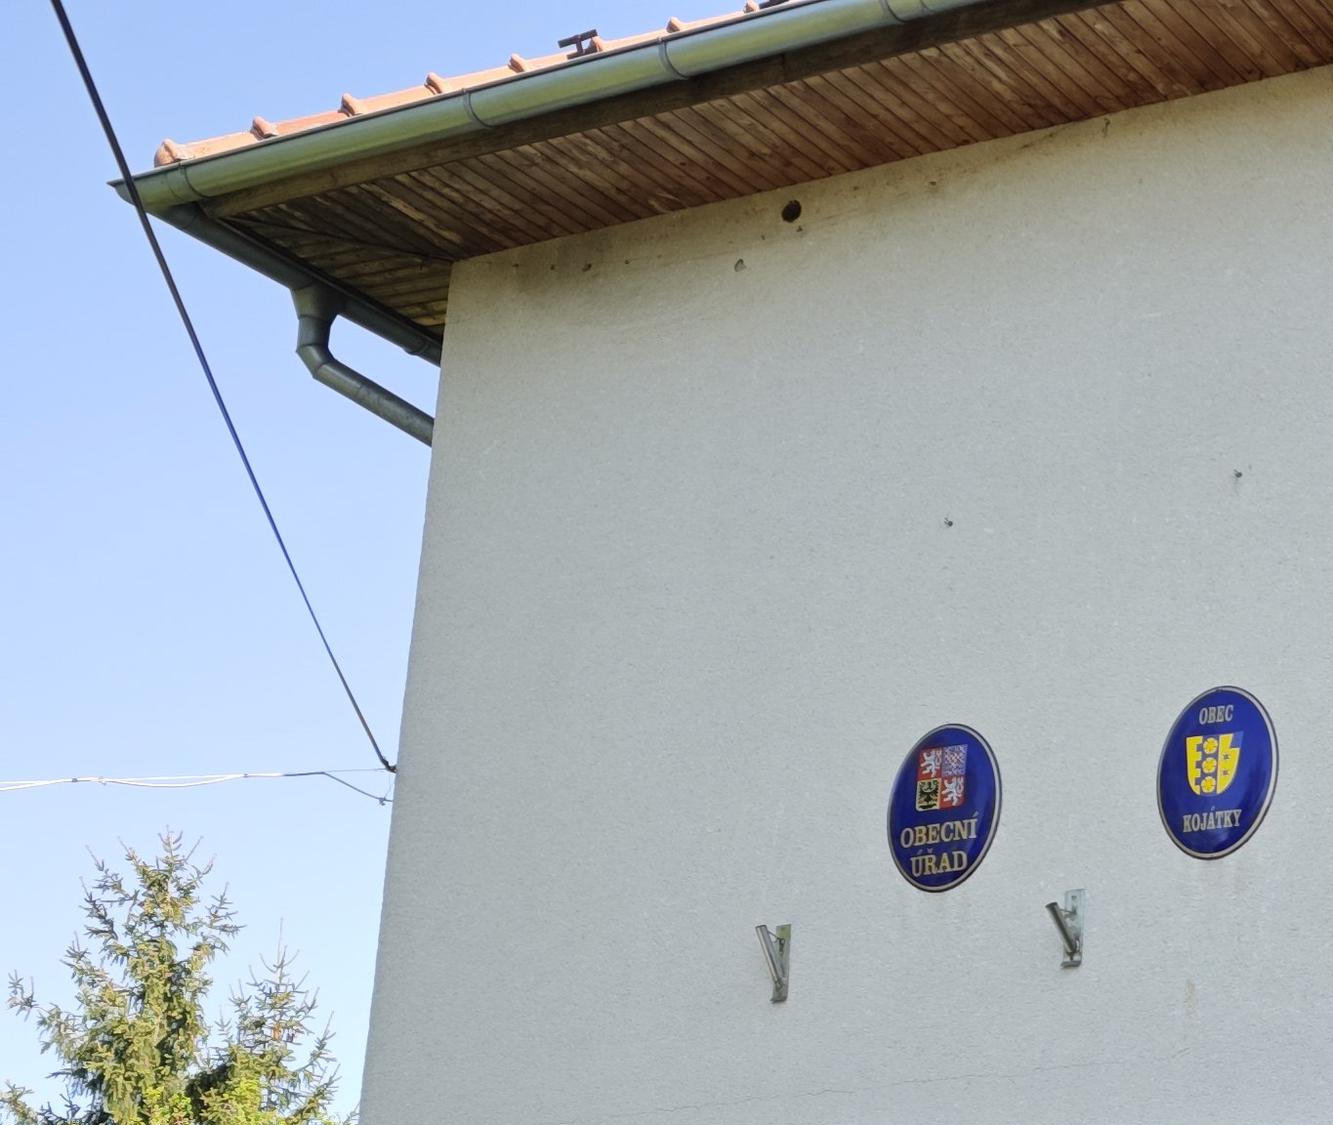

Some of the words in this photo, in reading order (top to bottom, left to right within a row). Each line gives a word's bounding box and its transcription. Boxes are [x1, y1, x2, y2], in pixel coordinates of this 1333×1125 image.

[1199, 704, 1234, 725] OBEC
[900, 811, 979, 848] OBECNÍ
[1183, 805, 1242, 833] KOJÁTKY
[910, 847, 968, 878] ÚŘAD
